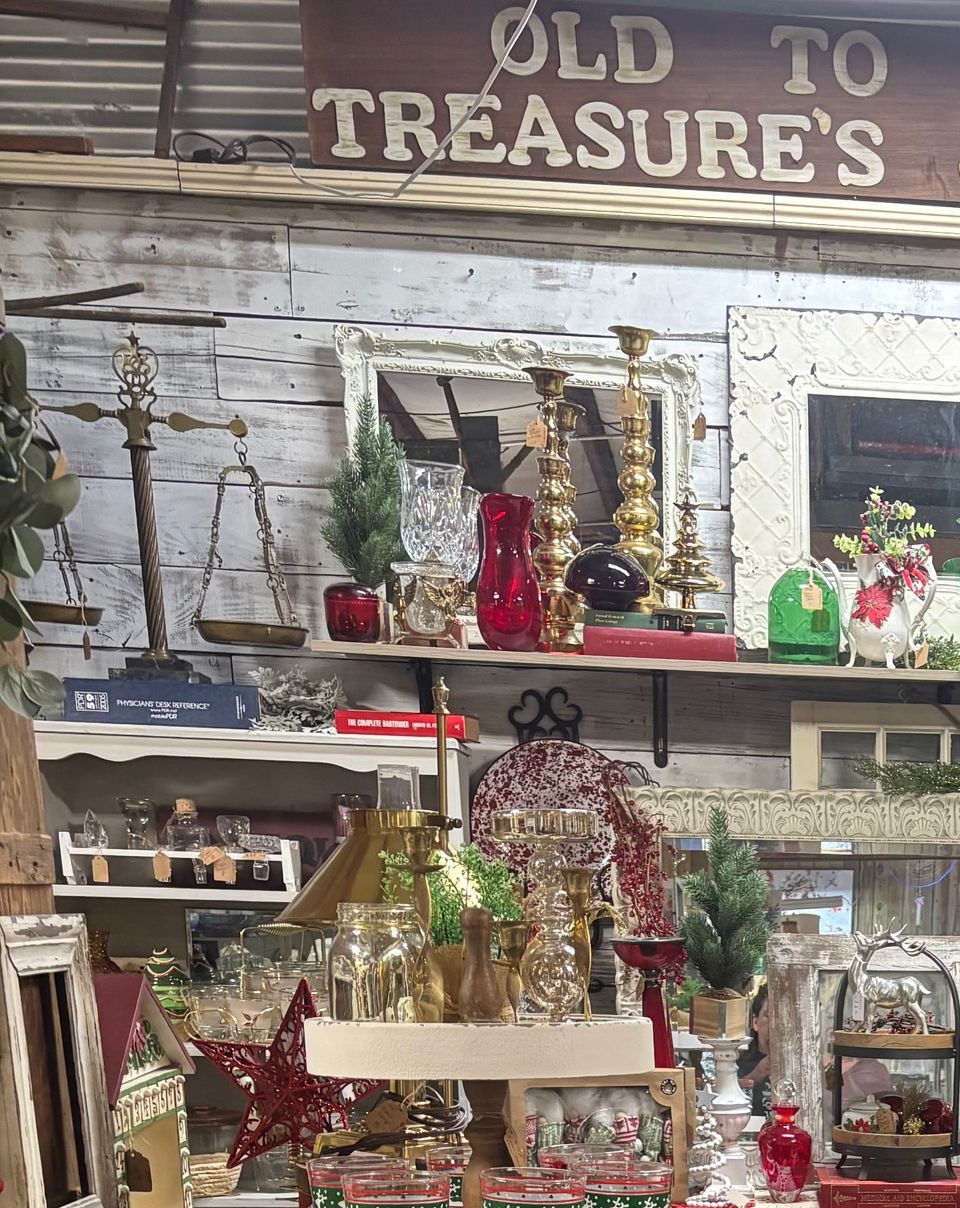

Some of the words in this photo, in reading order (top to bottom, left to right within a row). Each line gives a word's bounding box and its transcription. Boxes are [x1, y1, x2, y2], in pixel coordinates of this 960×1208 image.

[490, 6, 673, 84] OLD
[769, 25, 888, 97] TO
[311, 88, 885, 187] TREASURE'S
[348, 718, 356, 726] THE
[357, 719, 382, 727] COMPLETE
[861, 1194, 890, 1202] MEDICAL
[892, 1194, 904, 1202] AID
[905, 1194, 955, 1202] ENCYCLOPEDIA
